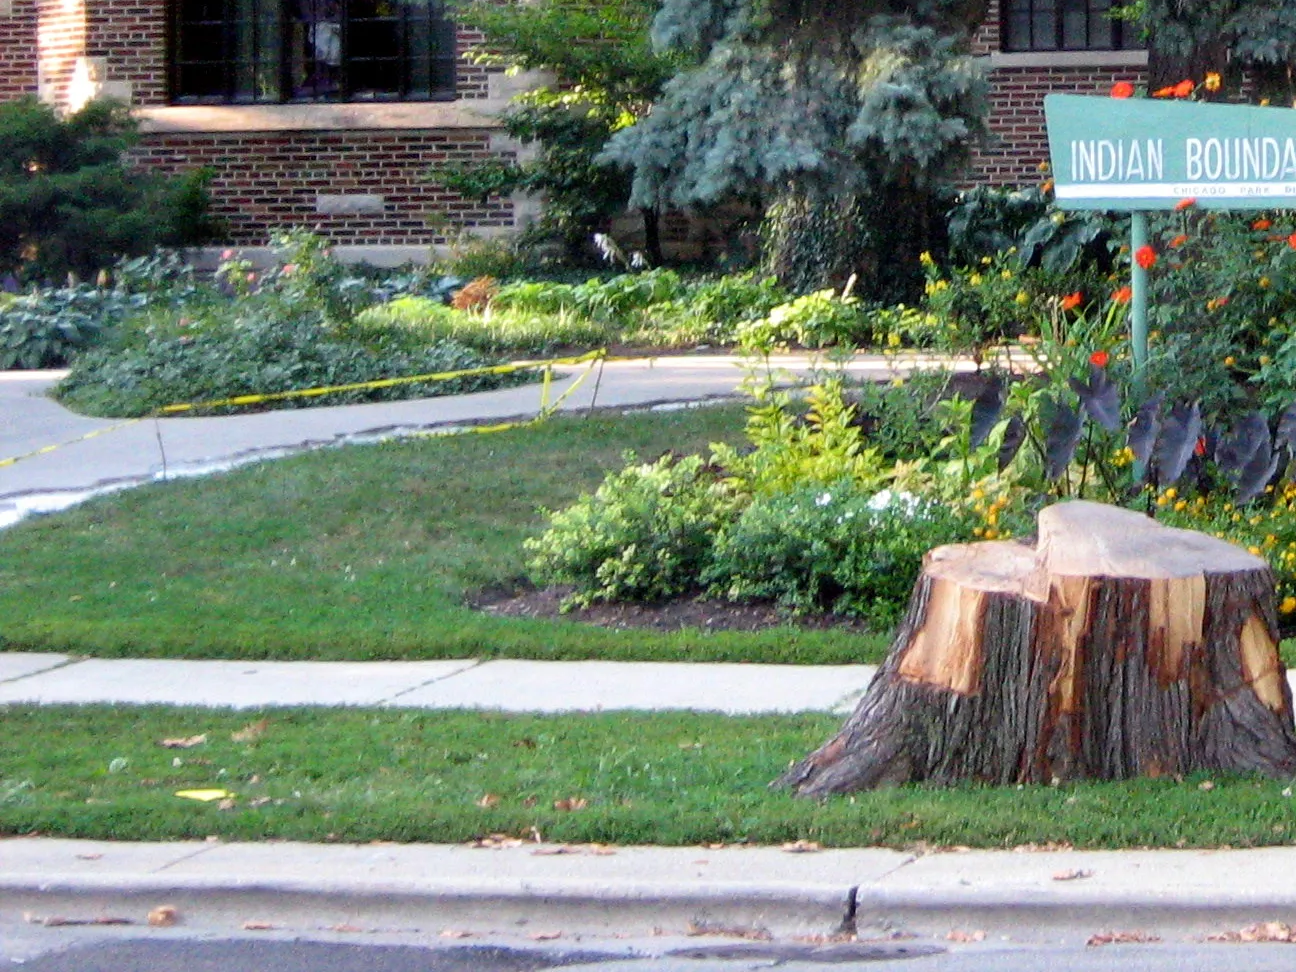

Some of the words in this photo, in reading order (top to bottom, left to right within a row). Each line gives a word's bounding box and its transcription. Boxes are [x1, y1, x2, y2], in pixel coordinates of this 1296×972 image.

[1070, 138, 1163, 182] INDIAN
[1173, 186, 1226, 195] CHICAGO
[1240, 186, 1271, 195] PARK
